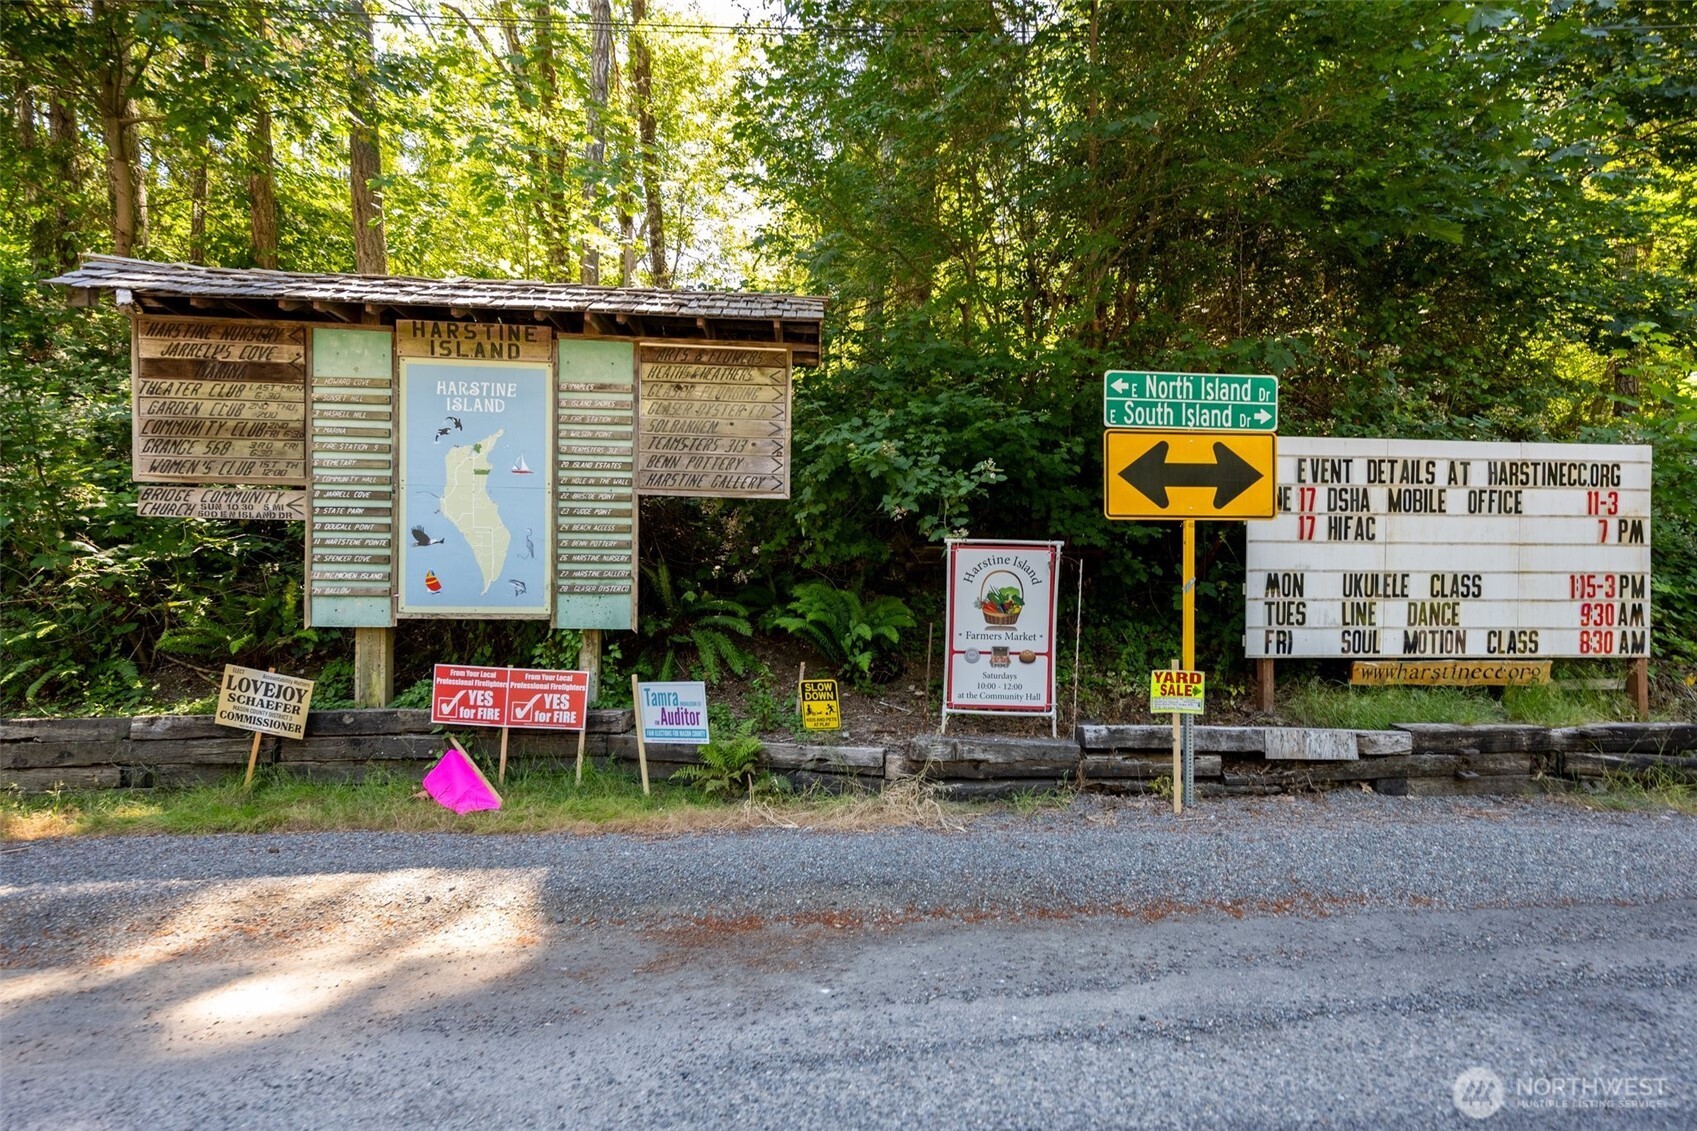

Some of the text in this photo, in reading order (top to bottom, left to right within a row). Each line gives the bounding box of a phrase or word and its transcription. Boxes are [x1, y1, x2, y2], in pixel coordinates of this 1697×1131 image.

[146, 321, 285, 343] HARSTINE NURSERY
[412, 320, 537, 343] HARSTINE
[239, 345, 279, 361] COVE
[430, 339, 520, 360] ISLAND
[139, 380, 203, 397] THEATER
[208, 383, 246, 398] CLUB
[436, 380, 517, 397] HARSTINE
[1131, 374, 1271, 402] E North Island Dr
[147, 400, 203, 416] GARDEN
[209, 402, 246, 417] CLUB
[446, 397, 505, 413] ISLAND
[1110, 400, 1251, 428] E South Island Dr
[141, 419, 227, 436] COMMUNITY
[231, 421, 267, 437] CLUB
[142, 438, 199, 455] GRANGE
[202, 440, 232, 455] 568
[648, 436, 749, 453] TEAMSTERS 313
[218, 460, 255, 476] CLUB
[646, 454, 745, 471] BENN POTTERY
[1297, 458, 1621, 487] EVENT DETAILS AT HARSTINECC.ORG
[646, 473, 767, 490] HARSTINE GALLERY
[141, 488, 285, 503] BRIDGE COMMUNITY
[1299, 486, 1316, 513] 17
[1327, 487, 1370, 513] DSHA
[1387, 487, 1446, 514] MOBILE
[1468, 489, 1523, 515] OFFICE
[1586, 491, 1619, 516] 11-3
[140, 502, 196, 516] CHURCH
[200, 503, 221, 511] SUN
[238, 511, 276, 519] ISLAND
[1298, 515, 1644, 544] 17 HIFAC 7 PM
[963, 554, 1043, 586] Harstine Island
[1264, 572, 1305, 598] MON
[1342, 573, 1410, 598] UKULELE
[1430, 573, 1483, 599] CLASS
[1264, 601, 1645, 627] TUES LINE DANCE 9:30 AM
[965, 631, 1037, 641] Farmers Market
[1264, 630, 1646, 655] FRI SOUL MOTION CLASS 8:30 AM
[436, 677, 474, 686] Professional
[450, 669, 466, 677] From
[542, 673, 556, 681] Your
[556, 674, 573, 682] Local
[982, 671, 1017, 681] Saturdays
[1153, 671, 1202, 684] YARD
[225, 674, 309, 704] LOVEJOY
[510, 681, 586, 691] Professional Firefighters
[804, 682, 832, 692] SLOW
[977, 682, 1023, 690] 10:00 12:00
[1160, 683, 1192, 697] SALE
[227, 692, 301, 715] SCHAEFER
[468, 689, 494, 707] YES
[543, 693, 570, 710] YES
[643, 687, 679, 707] Tamra
[804, 691, 834, 700] DOWN
[966, 691, 978, 699] the
[979, 692, 1024, 702] Community
[1025, 693, 1041, 701] Hall
[232, 704, 289, 721] MASON COUNTY DISTRICT
[459, 706, 501, 720] for FIRE
[534, 710, 577, 724] for FIRE
[660, 706, 701, 726] Auditor
[219, 709, 302, 734] COMMISSIONER
